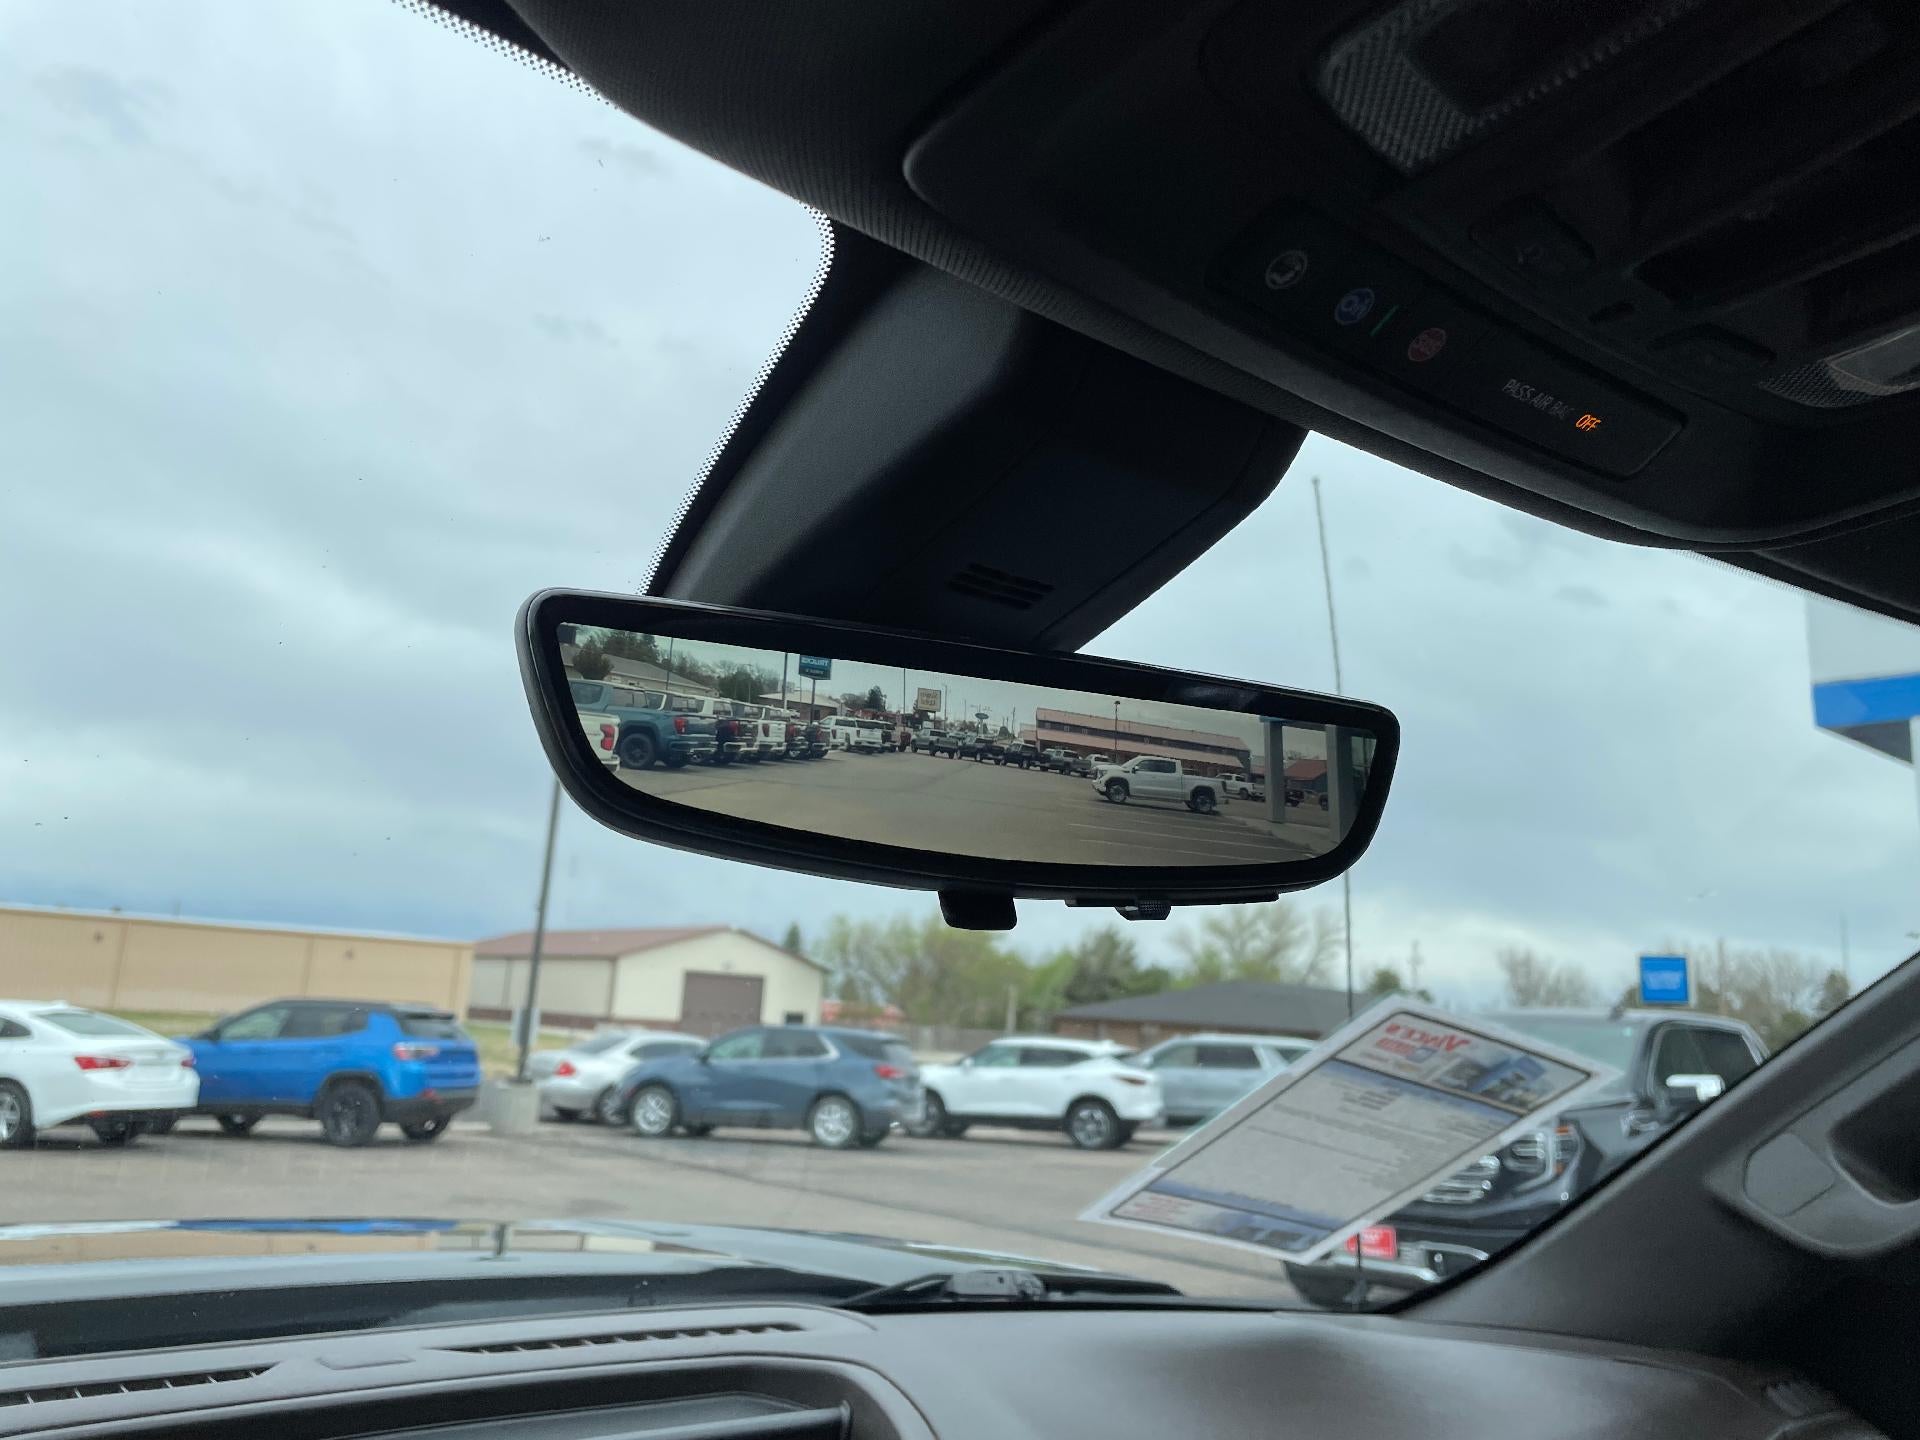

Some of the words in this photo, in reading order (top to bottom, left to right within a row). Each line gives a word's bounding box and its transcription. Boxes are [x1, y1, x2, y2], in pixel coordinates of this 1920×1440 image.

[1502, 378, 1536, 401] PASS
[1529, 392, 1555, 411] AIR
[1575, 413, 1603, 432] OFF
